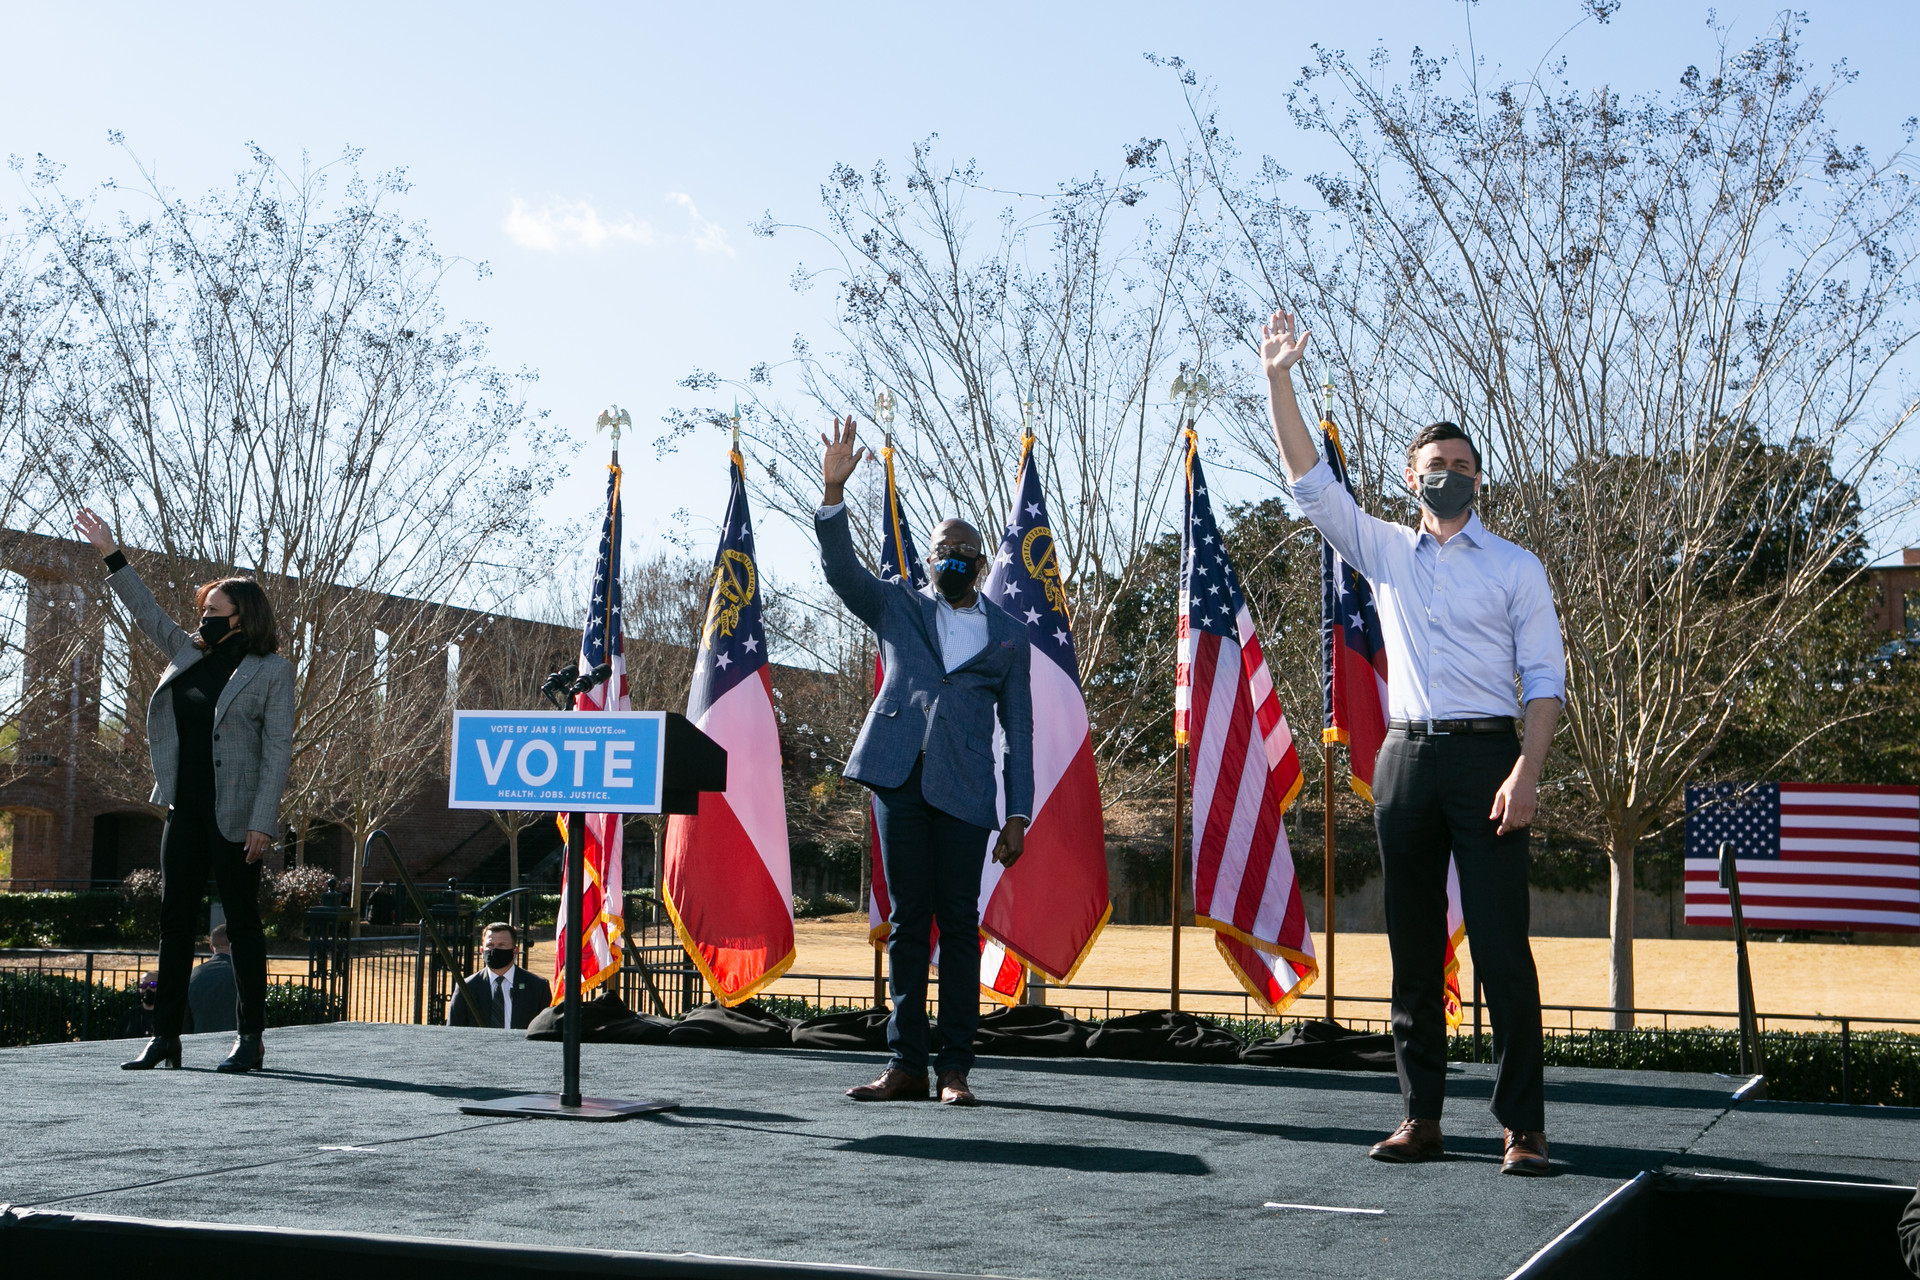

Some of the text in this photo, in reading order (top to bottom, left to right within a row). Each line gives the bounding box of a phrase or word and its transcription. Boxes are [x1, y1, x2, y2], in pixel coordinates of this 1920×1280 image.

[933, 558, 967, 574] VOTE
[490, 725, 514, 733] VOTE
[516, 725, 529, 733] BY
[530, 726, 548, 734] JAN
[550, 726, 557, 734] 5
[475, 739, 635, 788] VOTE
[498, 789, 611, 800] HEALTH. JOBS. JUSTICE.
